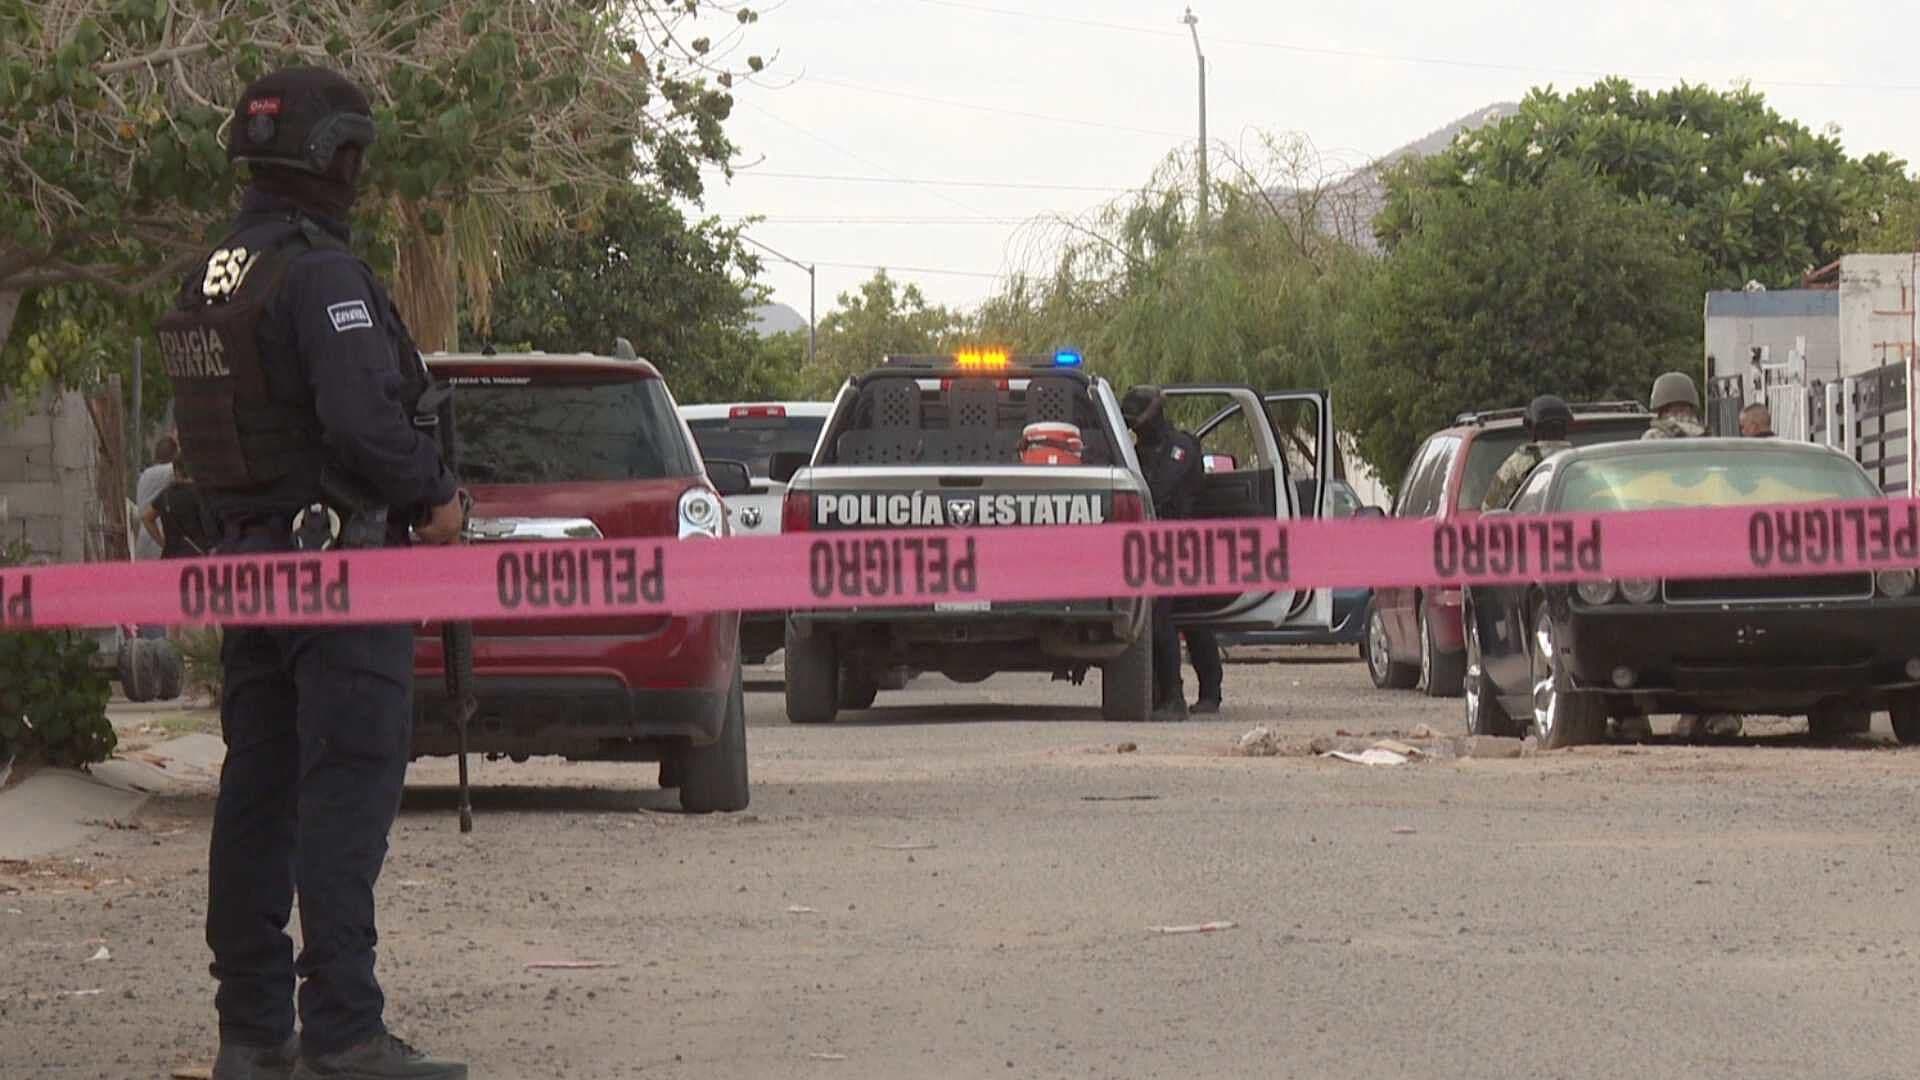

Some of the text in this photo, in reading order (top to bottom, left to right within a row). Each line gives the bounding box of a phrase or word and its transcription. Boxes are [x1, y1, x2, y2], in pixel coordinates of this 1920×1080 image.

[817, 490, 1104, 525] POLICÍA ESTATAL
[1749, 505, 1920, 568] PELIGRO
[497, 547, 665, 608] PELIGRO
[810, 536, 977, 597] PELIGRO
[1122, 527, 1291, 588] PELIGRO
[1433, 519, 1602, 577] PELIGRO
[180, 560, 350, 618] PELIGRO
